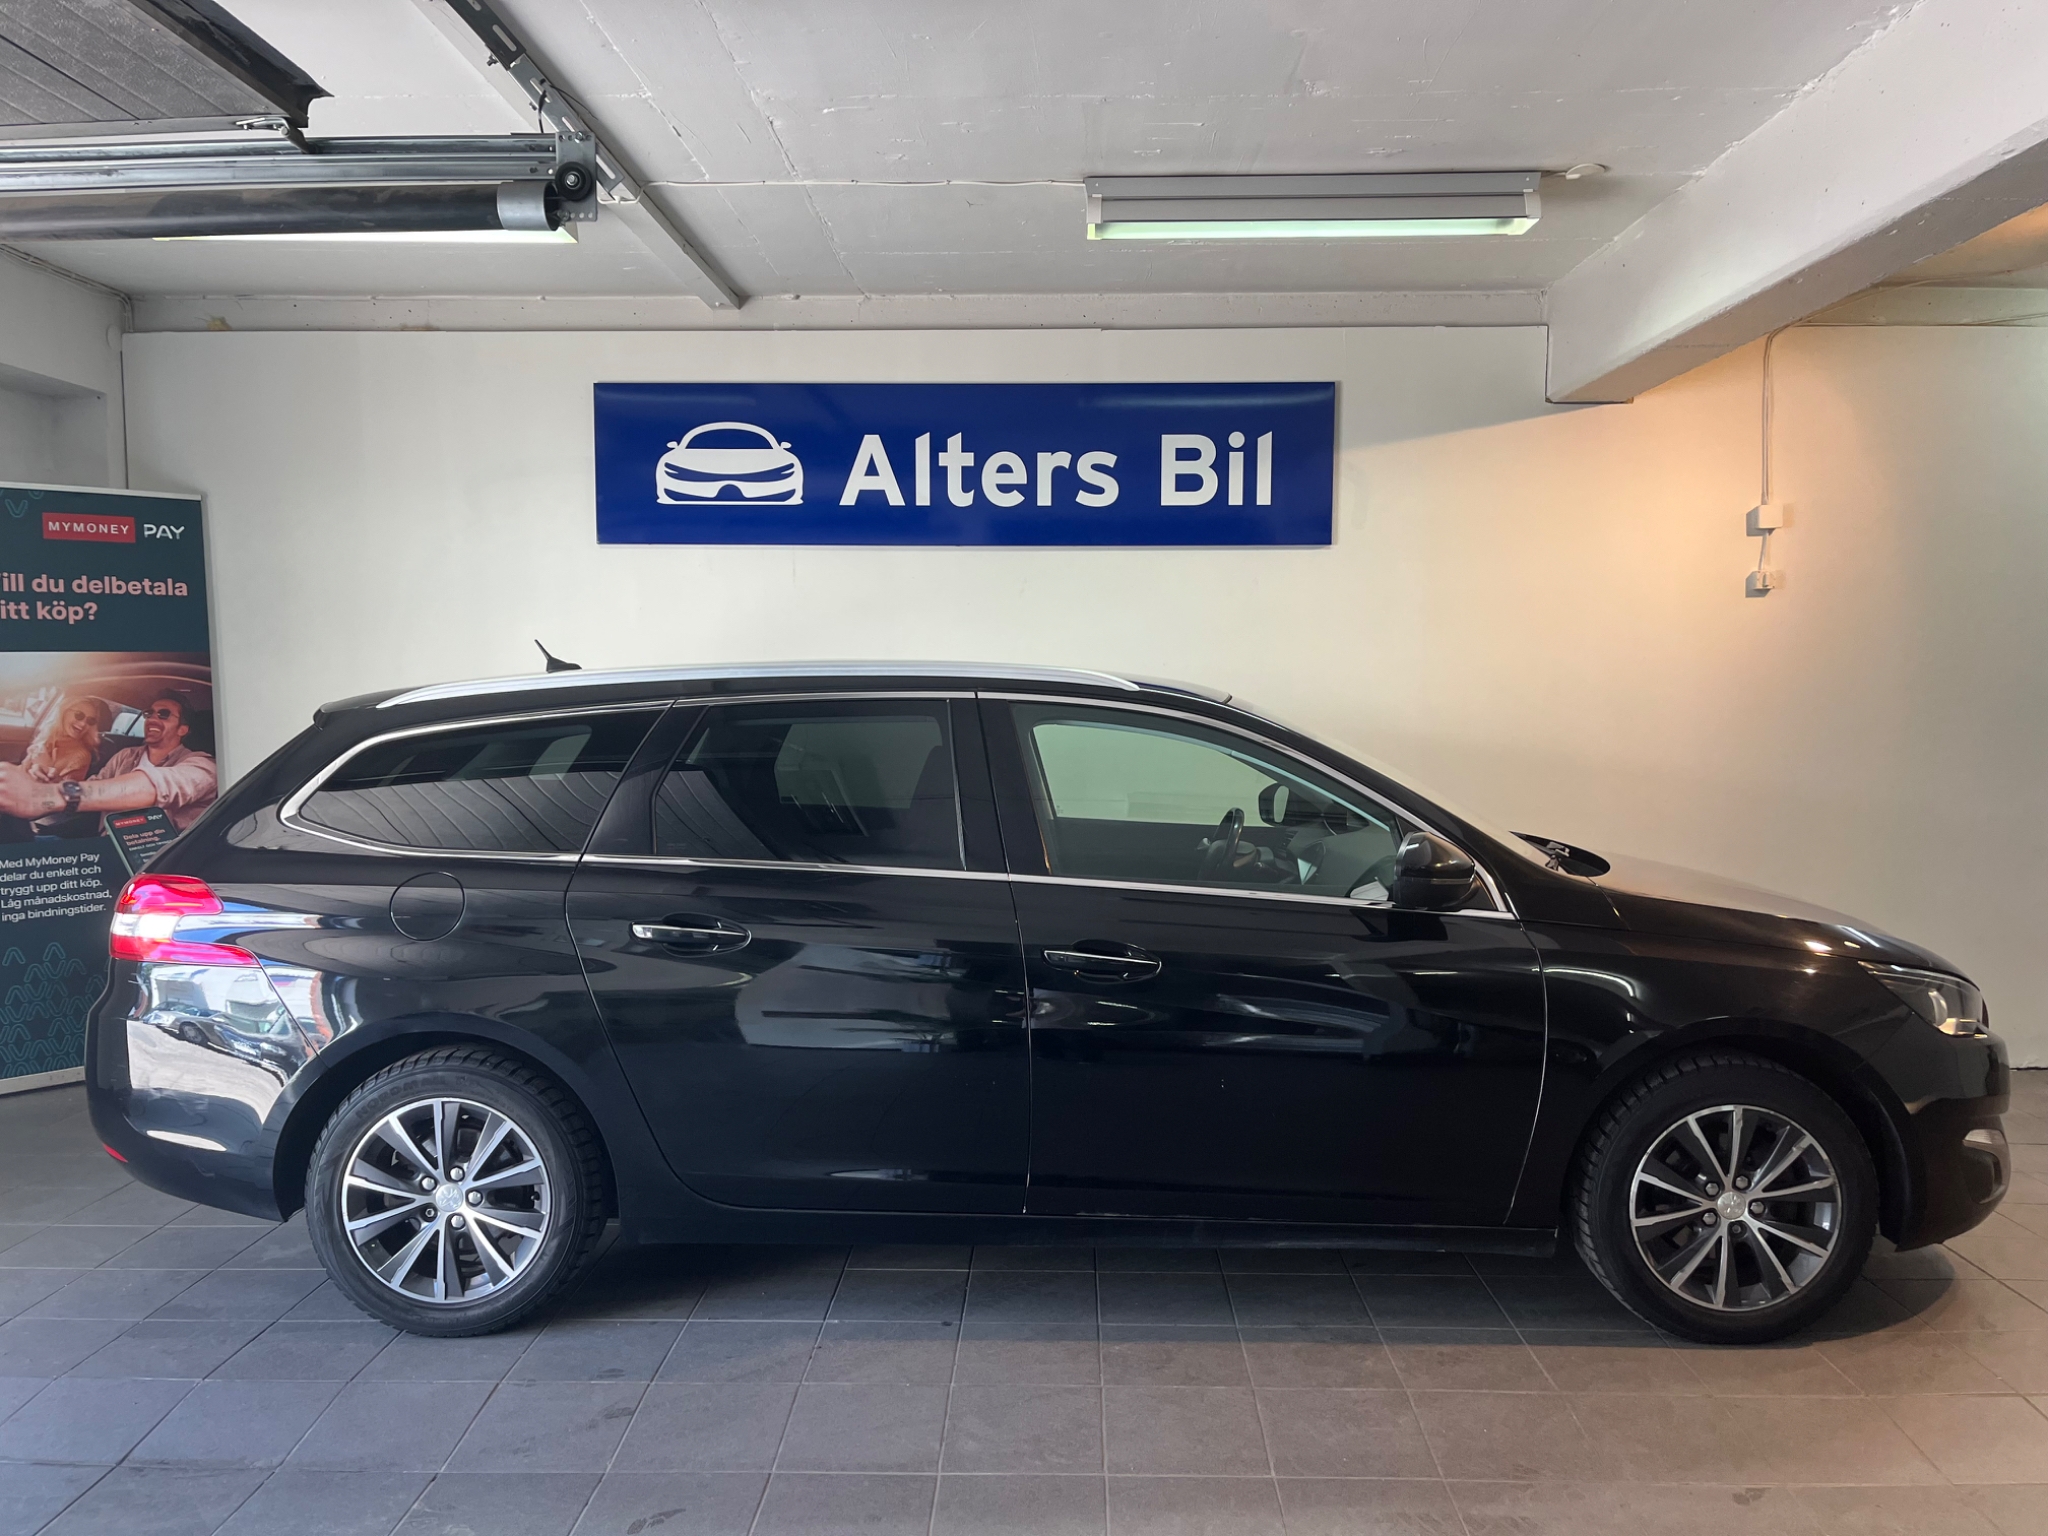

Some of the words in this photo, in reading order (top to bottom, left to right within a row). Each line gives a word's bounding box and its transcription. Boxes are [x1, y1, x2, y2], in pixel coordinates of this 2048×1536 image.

[839, 431, 1120, 508] Alters
[1160, 431, 1273, 507] Bil
[48, 521, 130, 535] MYMONEY
[143, 523, 185, 540] PAY
[0, 571, 25, 593] ill
[31, 573, 65, 593] du
[72, 575, 188, 597] delbetala
[0, 599, 31, 620] itt
[36, 600, 98, 624] köp?
[0, 859, 23, 869] Med
[25, 855, 78, 868] MyMoney
[80, 853, 100, 863] Pay
[0, 872, 27, 882] delar
[29, 870, 44, 880] du
[46, 867, 79, 878] enkelt
[81, 865, 101, 875] och
[0, 884, 34, 897] tryggt
[36, 883, 58, 893] upp
[60, 880, 78, 890] ditt
[80, 878, 103, 889] köp.
[1, 898, 22, 909] Låg
[1, 912, 26, 923] inga
[28, 903, 107, 919] bindningstider.
